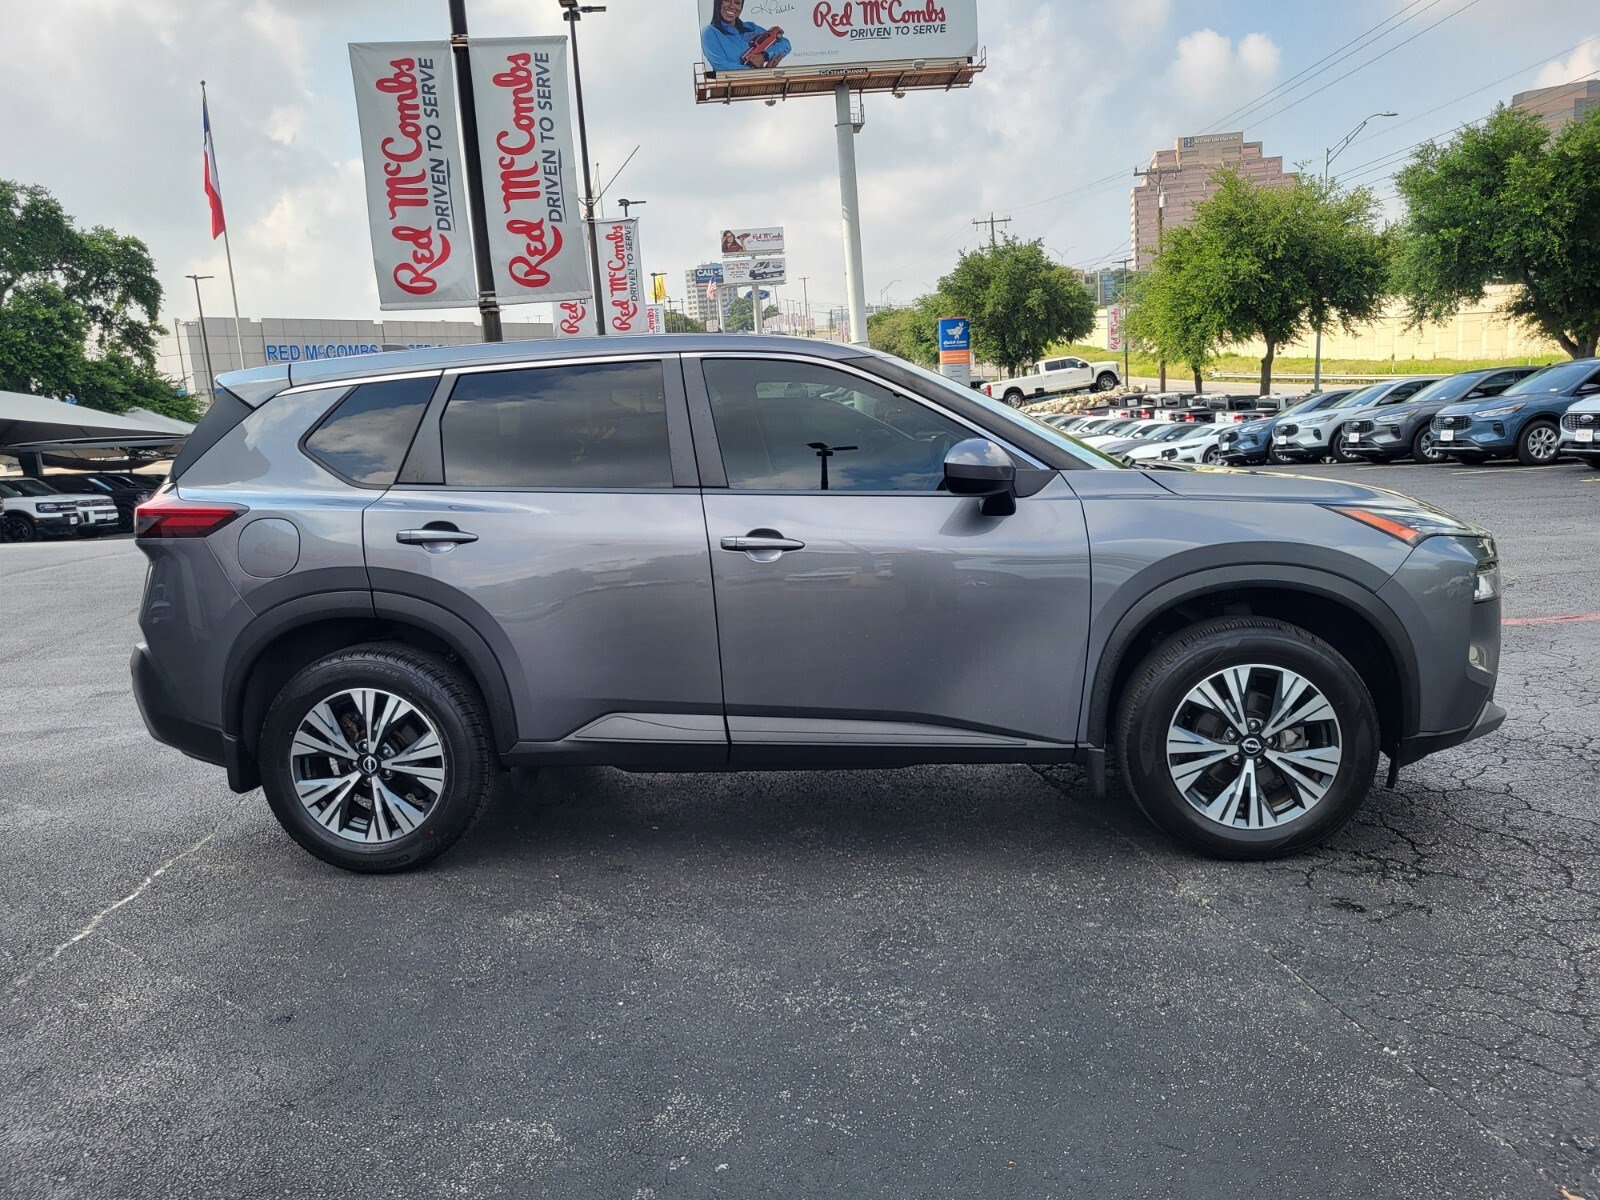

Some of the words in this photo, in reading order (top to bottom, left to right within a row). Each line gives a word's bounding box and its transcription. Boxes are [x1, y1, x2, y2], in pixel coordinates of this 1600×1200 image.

[812, 1, 853, 37] Red
[856, 0, 946, 25] McCombs
[850, 27, 891, 38] DRIVEN
[895, 26, 910, 35] TO
[913, 24, 946, 34] SERVE
[418, 58, 439, 118] SERVE
[534, 52, 553, 111] SERVE
[376, 58, 428, 220] McCombs
[426, 124, 442, 151] TO
[492, 53, 541, 214] McCombs
[539, 116, 555, 143] TO
[429, 158, 451, 232] DRIVEN
[543, 149, 562, 222] DRIVEN
[506, 217, 563, 288] Red
[625, 225, 633, 251] SERVE
[393, 225, 451, 295] Red
[605, 225, 628, 297] McCombs
[627, 253, 634, 266] TO
[629, 268, 638, 302] DRIVEN
[560, 302, 586, 334] Red
[612, 299, 638, 331] Red
[647, 308, 655, 334] ombs
[266, 344, 301, 361] RED
